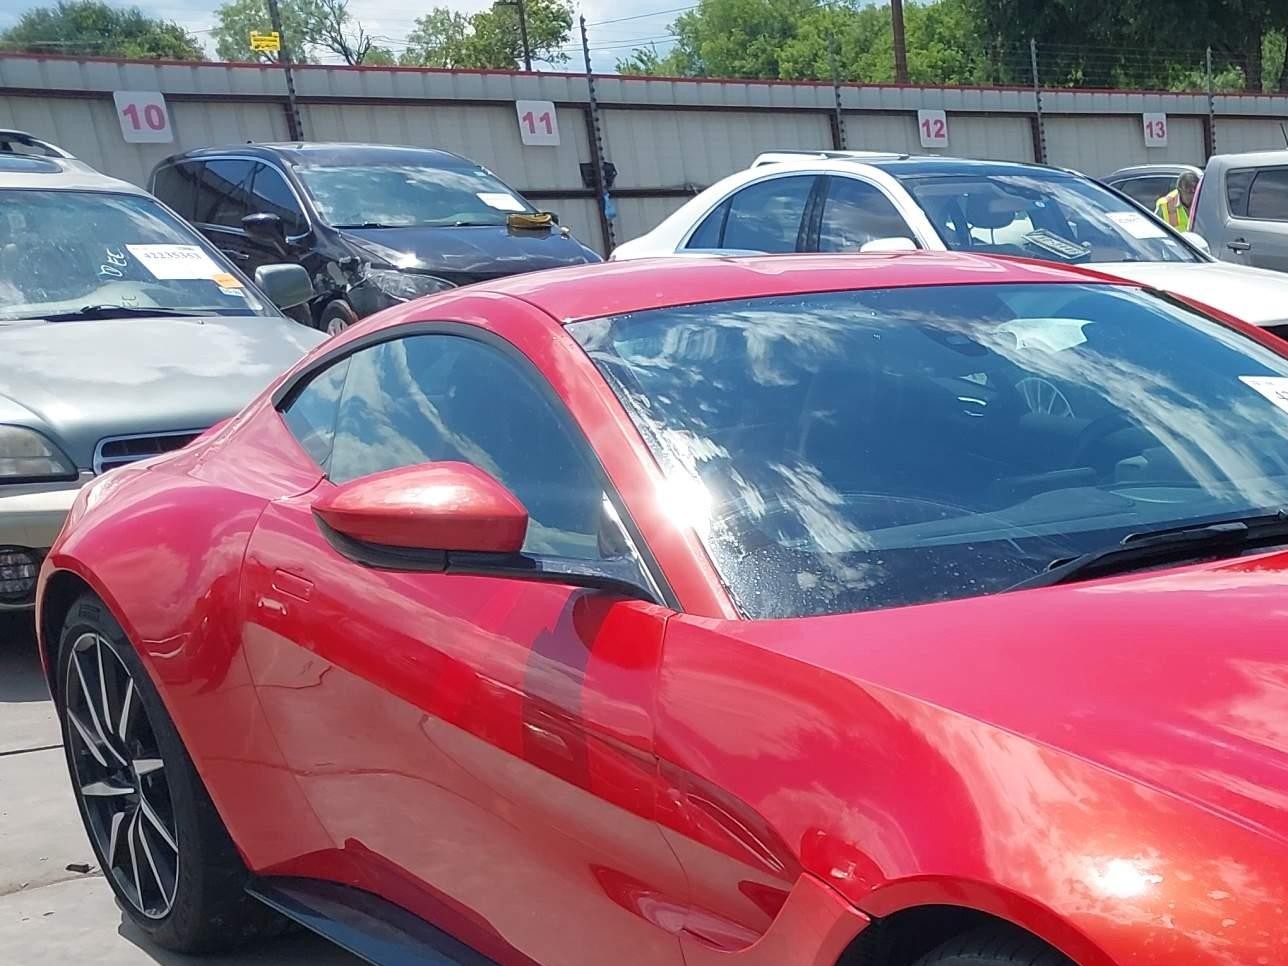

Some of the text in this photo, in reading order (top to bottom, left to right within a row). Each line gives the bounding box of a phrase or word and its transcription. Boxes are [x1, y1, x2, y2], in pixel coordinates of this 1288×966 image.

[122, 103, 166, 130] 10
[522, 111, 553, 135] 11
[922, 119, 945, 138] 12
[1146, 121, 1165, 139] 13
